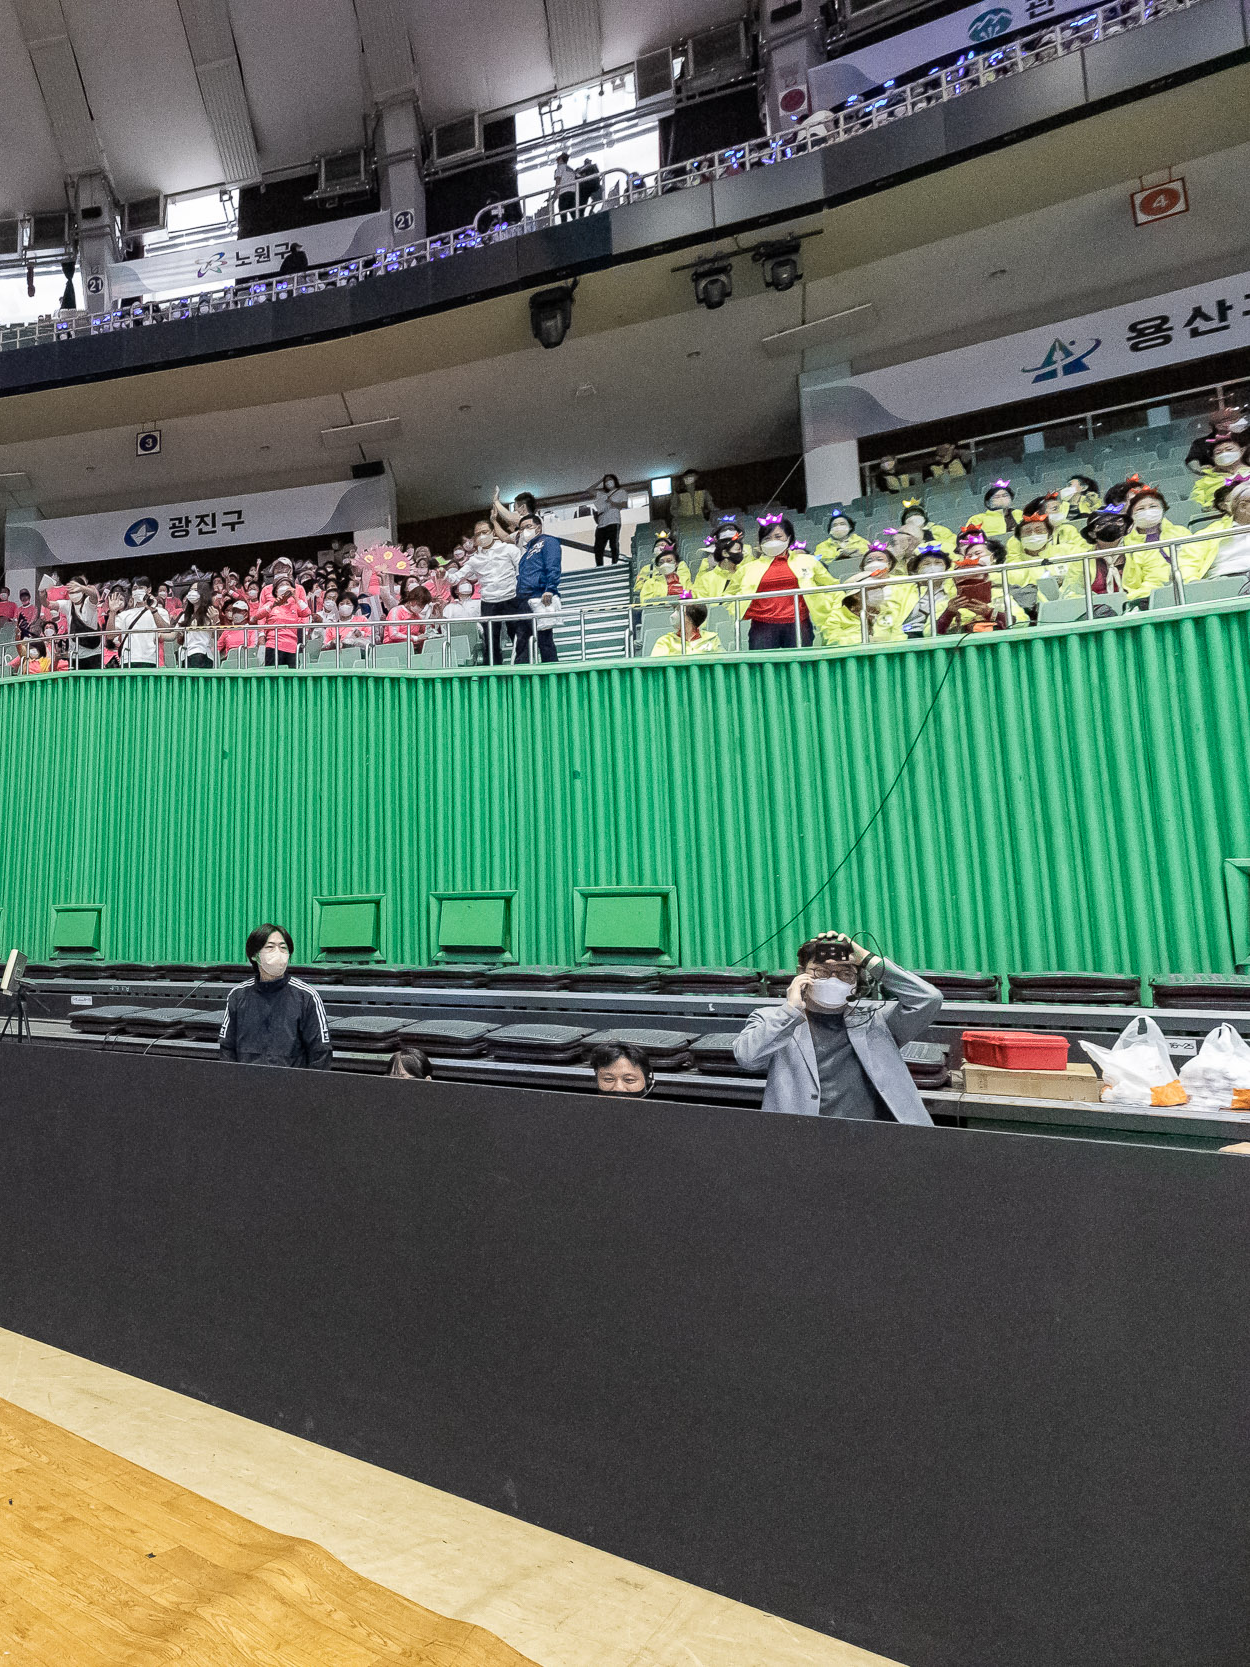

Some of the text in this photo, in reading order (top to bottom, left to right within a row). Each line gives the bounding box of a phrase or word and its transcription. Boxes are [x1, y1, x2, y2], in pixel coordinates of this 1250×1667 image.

[1152, 193, 1169, 208] 4
[397, 213, 411, 228] 21
[235, 242, 291, 267] 노원구
[89, 280, 102, 291] 21
[1126, 293, 1250, 352] 용산
[169, 510, 245, 538] 광진구
